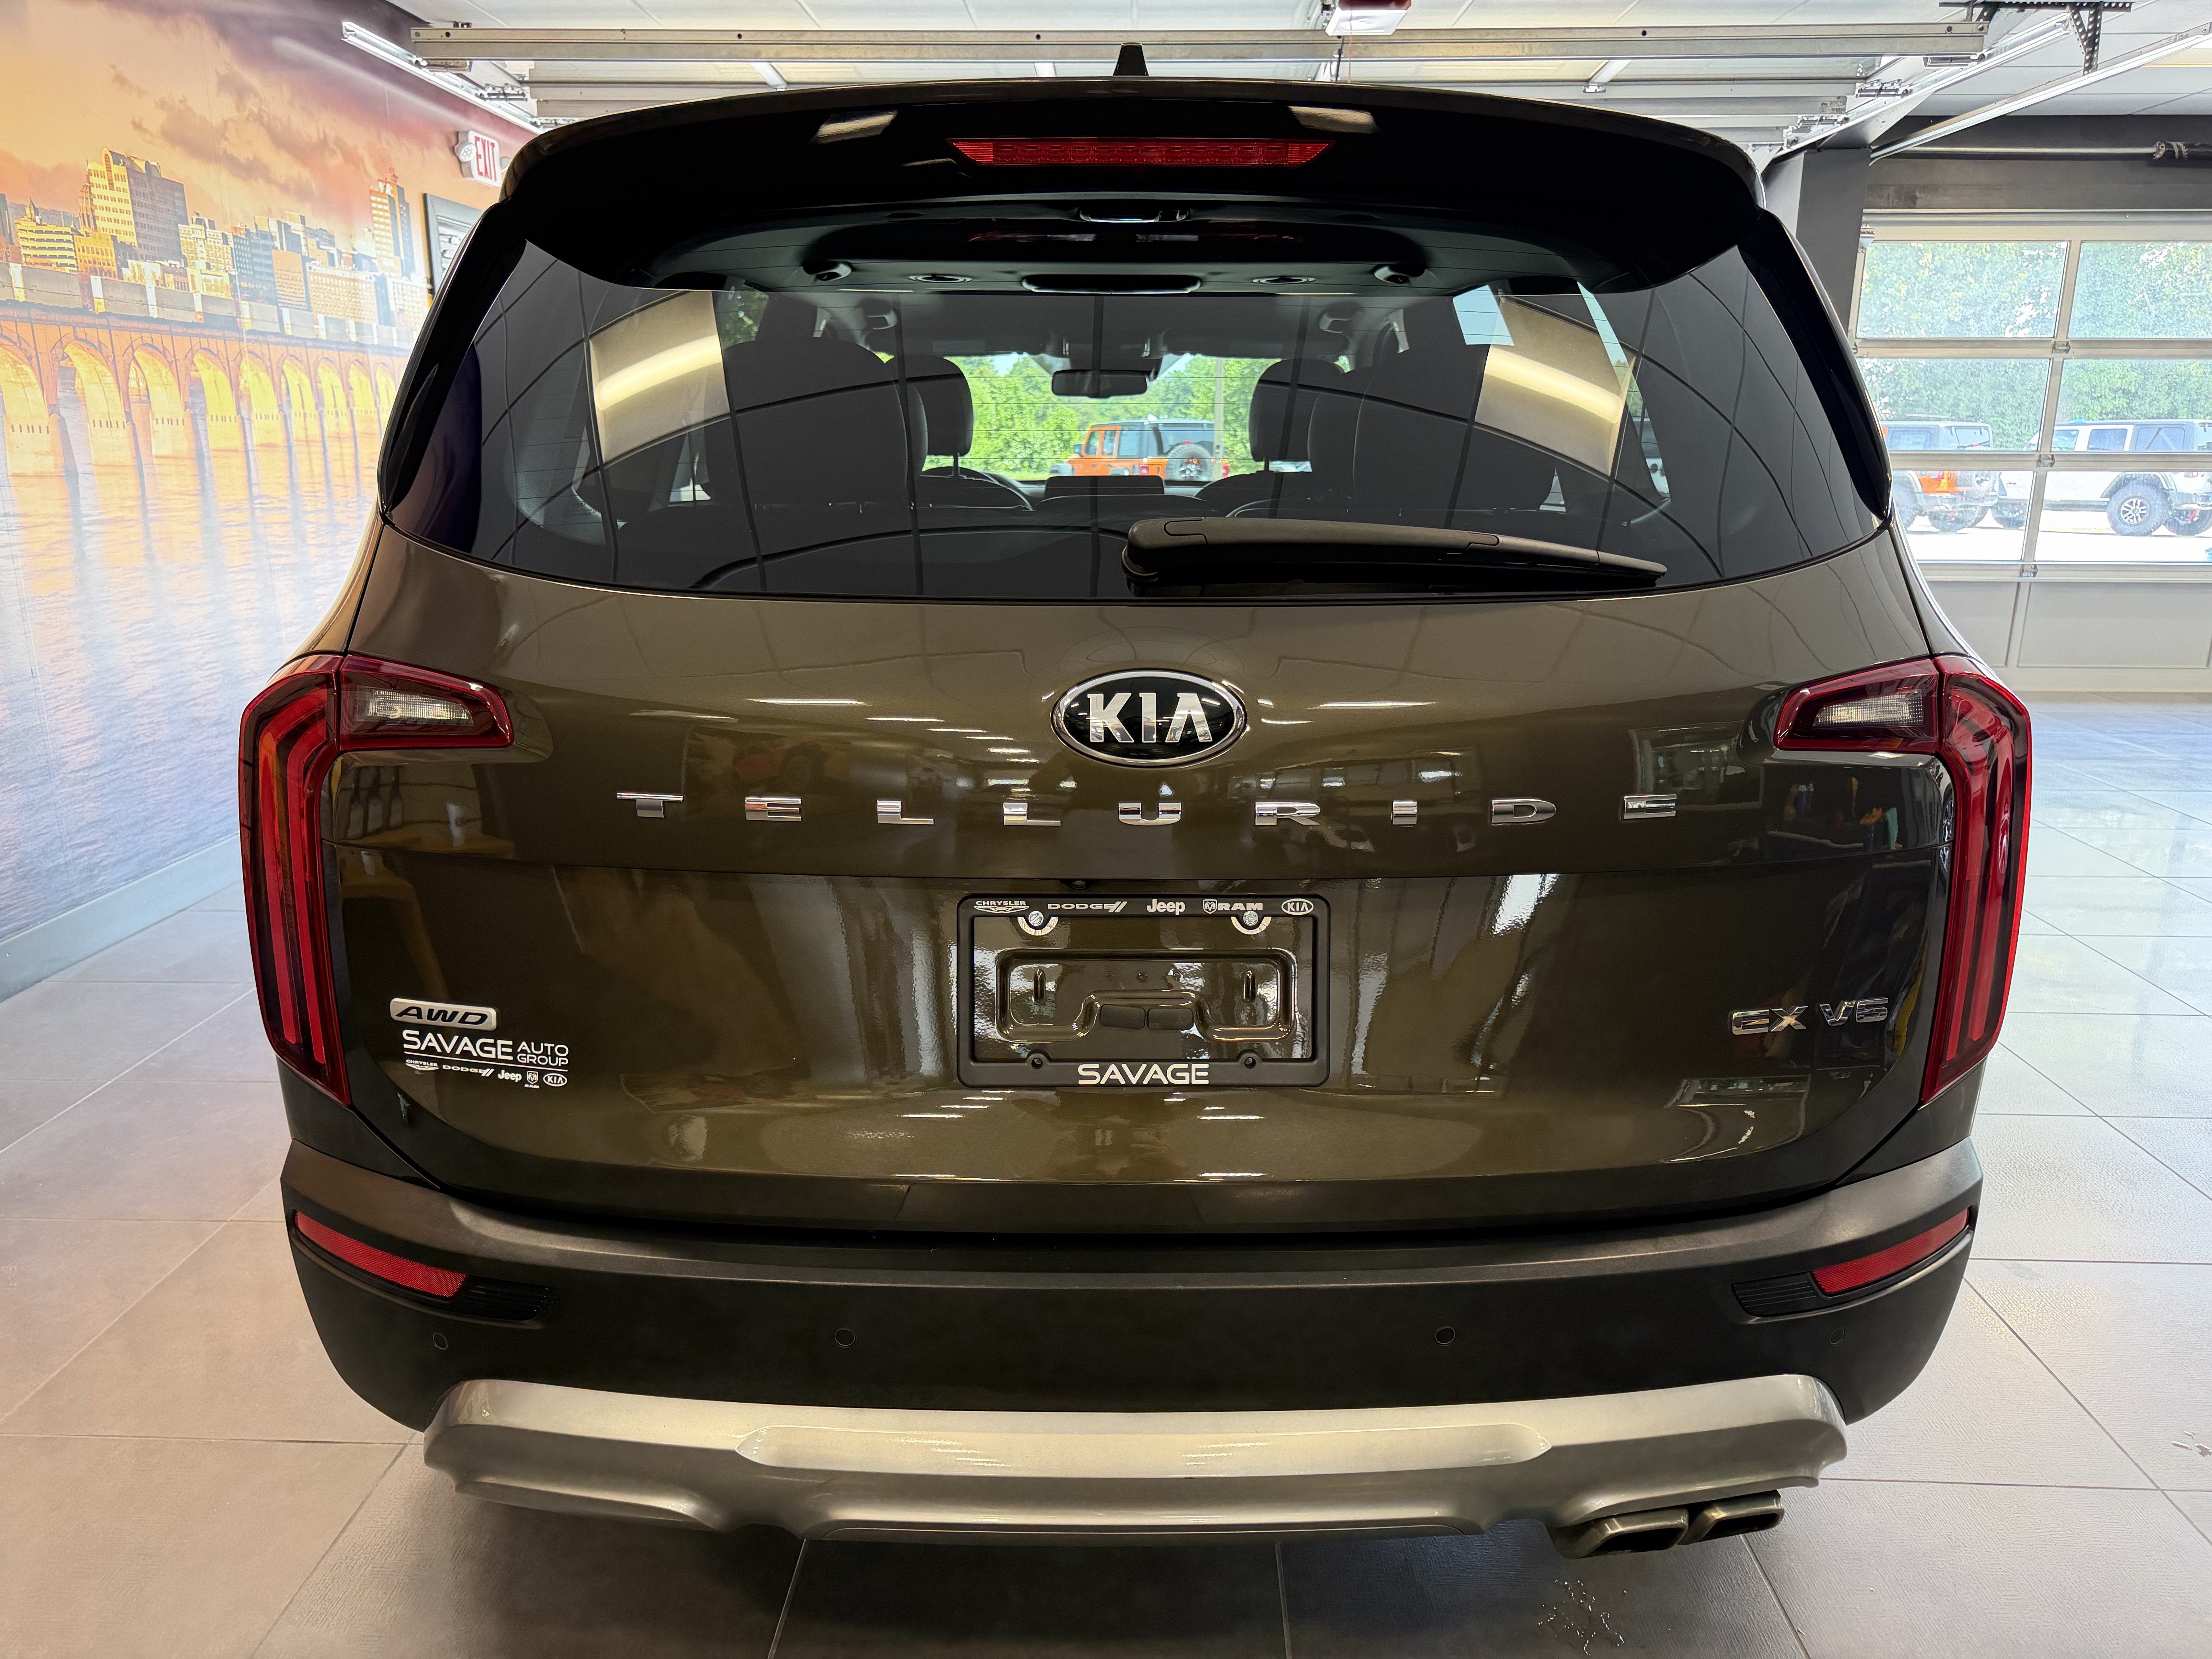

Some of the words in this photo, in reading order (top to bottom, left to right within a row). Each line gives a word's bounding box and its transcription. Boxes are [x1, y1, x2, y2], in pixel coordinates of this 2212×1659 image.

[474, 136, 497, 182] EXIT
[1087, 692, 1212, 743] KIA
[616, 792, 1677, 826] TELLURIDE
[1147, 898, 1185, 915] Jeep
[1287, 902, 1309, 911] KIA
[395, 1006, 488, 1025] AWD
[1732, 1006, 1808, 1035] EX
[1819, 997, 1888, 1026] V6
[402, 1029, 514, 1060] SAVAGE
[517, 1041, 569, 1056] AUTO
[517, 1053, 568, 1066] GROUP
[498, 1070, 522, 1082] Jeep
[547, 1075, 564, 1084] KIA
[1078, 1063, 1209, 1085] SAVAGE
